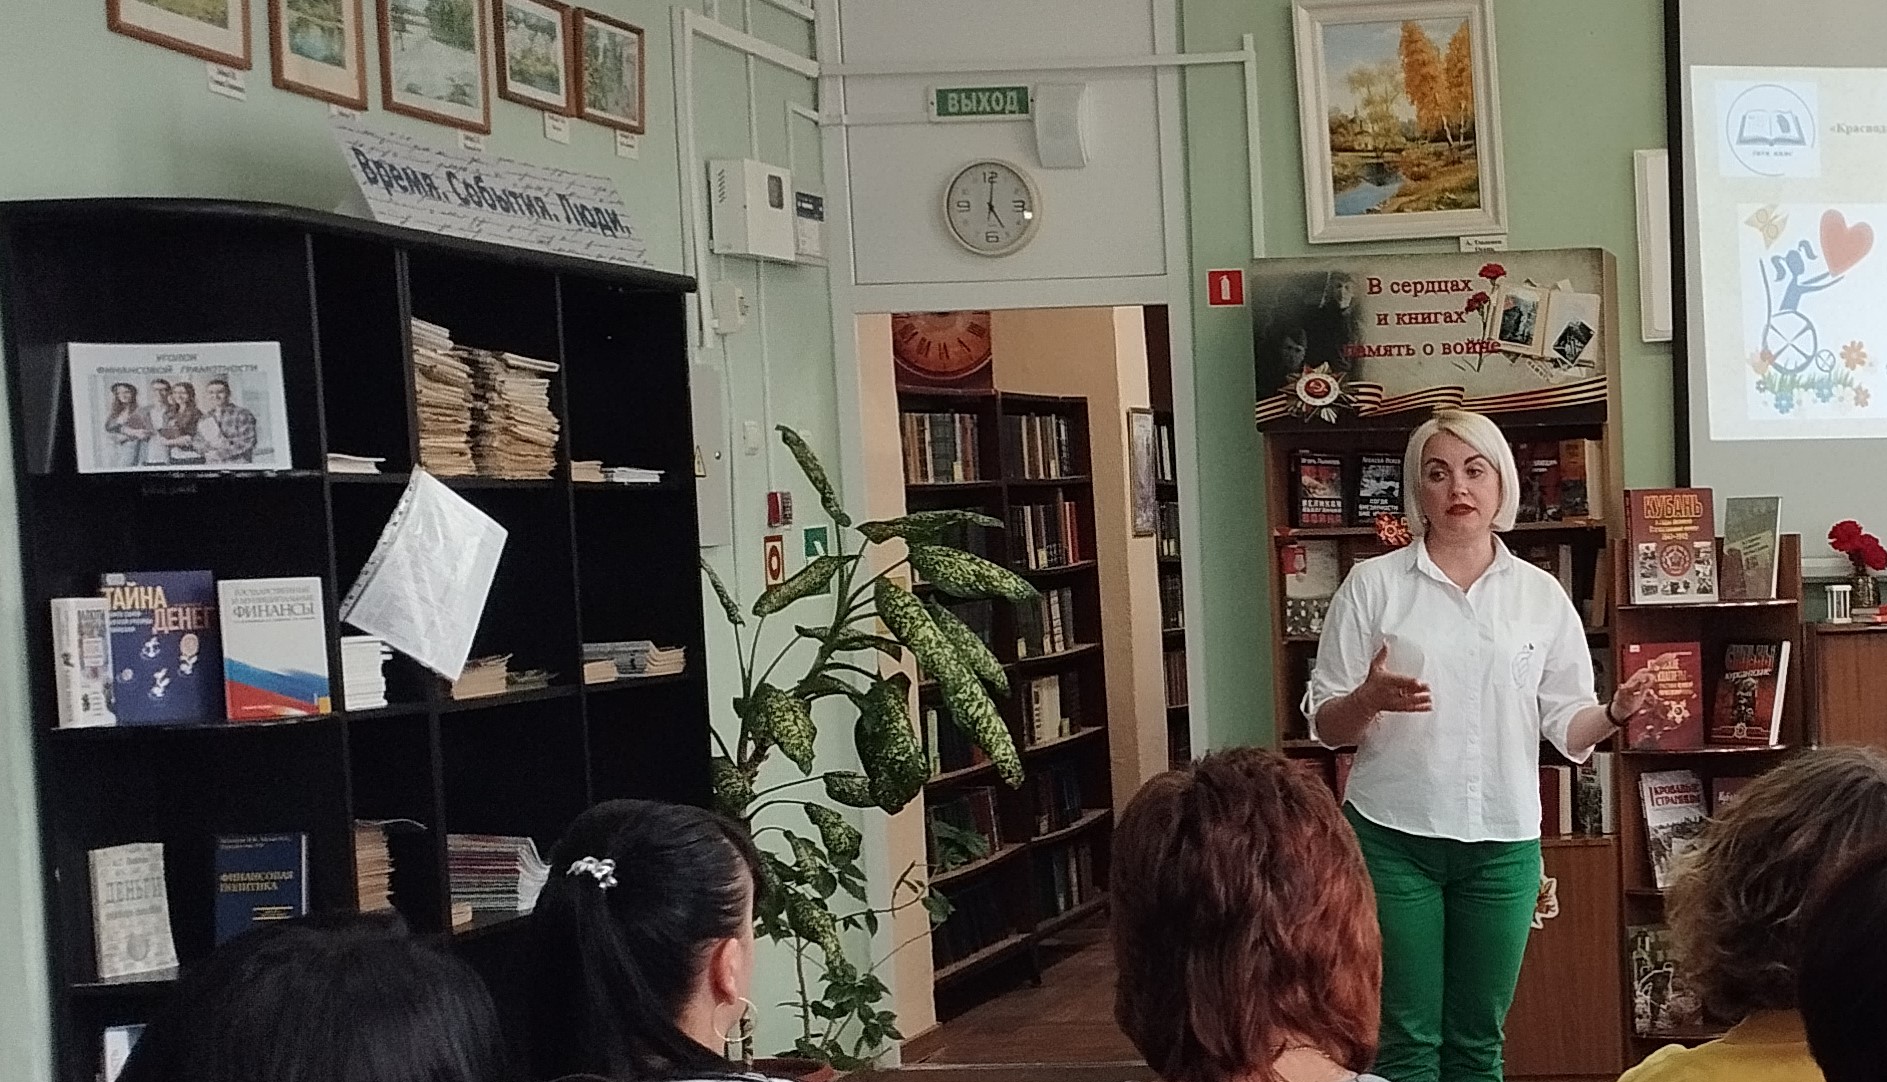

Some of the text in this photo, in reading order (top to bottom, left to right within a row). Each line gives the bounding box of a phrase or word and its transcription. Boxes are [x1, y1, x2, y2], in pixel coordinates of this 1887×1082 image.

[947, 90, 1019, 115] ВЫХОД
[982, 170, 999, 185] 12
[351, 146, 633, 239] Время. События. Люди.
[1366, 277, 1474, 298] В сердцах
[1376, 309, 1467, 326] и книгах
[1342, 337, 1502, 361] память о войне
[1643, 493, 1704, 519] КУБАНЬ
[101, 581, 168, 610] ТАЙНА
[151, 606, 216, 635] ДЕНЕГ
[232, 602, 316, 619] ФИНАНСЫ
